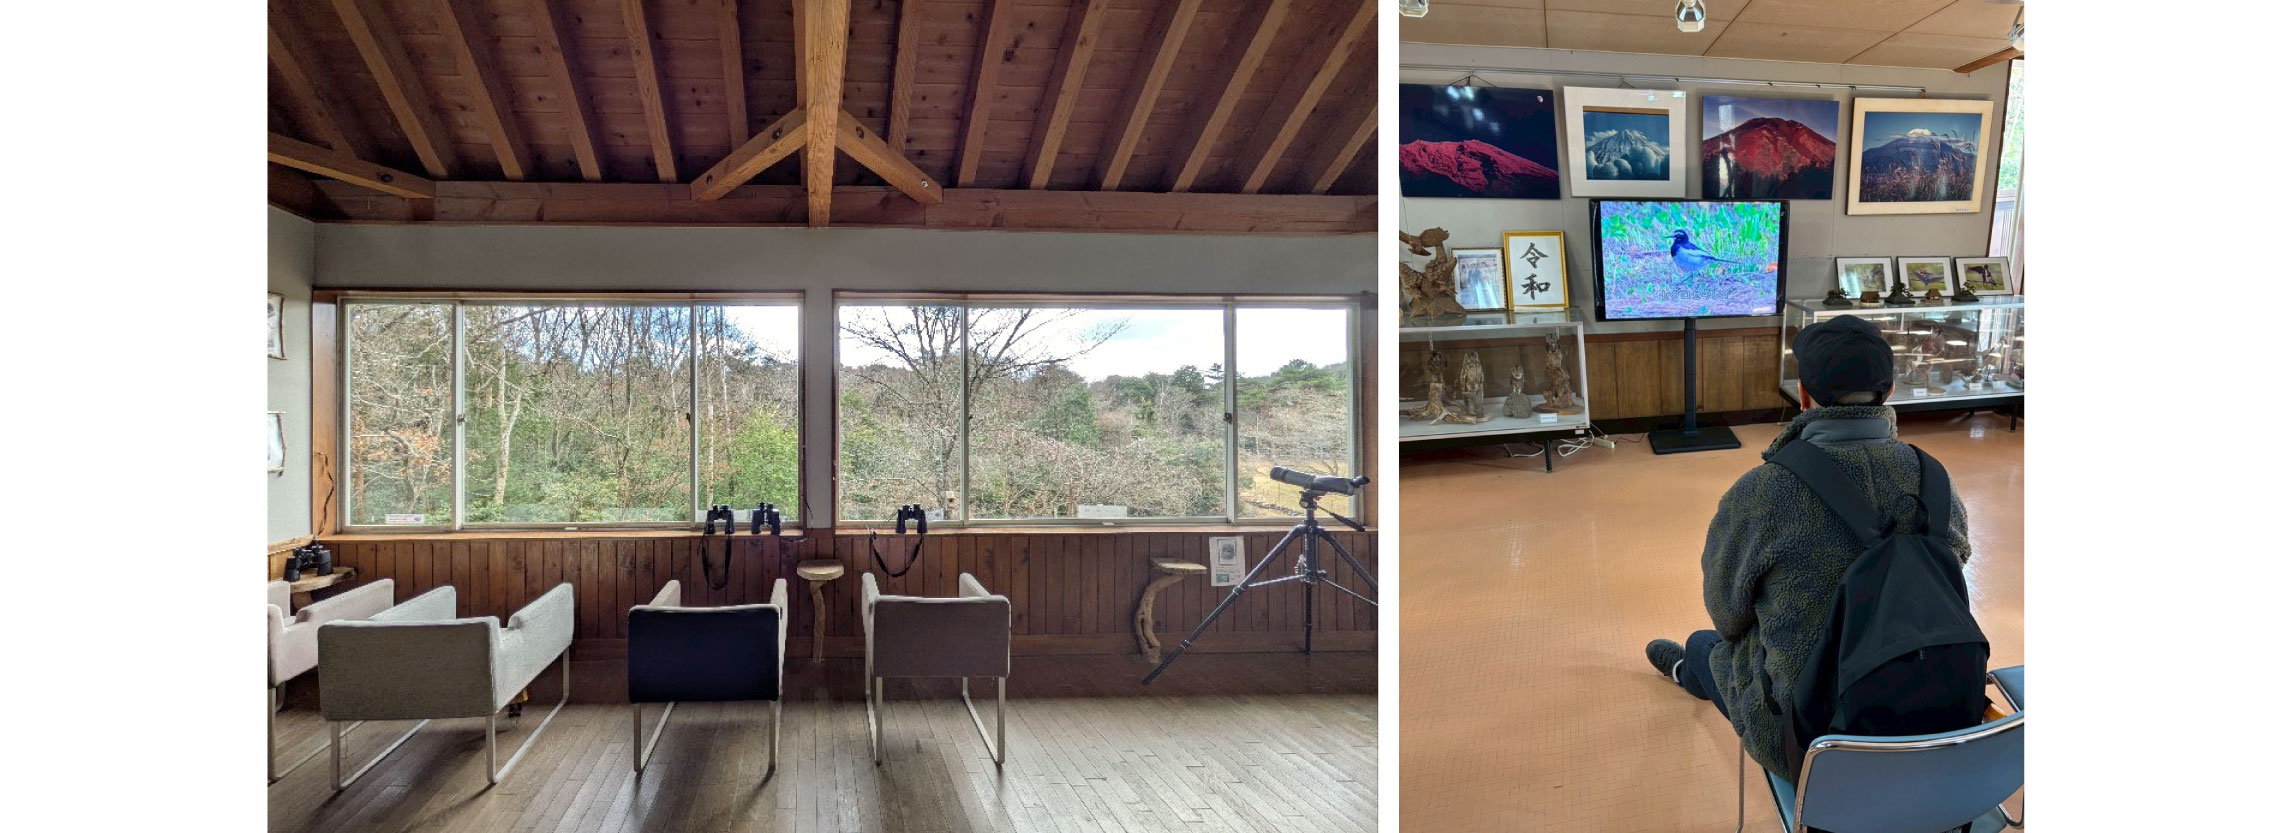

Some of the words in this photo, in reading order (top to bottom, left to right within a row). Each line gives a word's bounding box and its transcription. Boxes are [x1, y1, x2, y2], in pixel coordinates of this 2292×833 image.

[1520, 242, 1551, 300] 令和
[1661, 288, 1730, 303] セグロセキレイ
